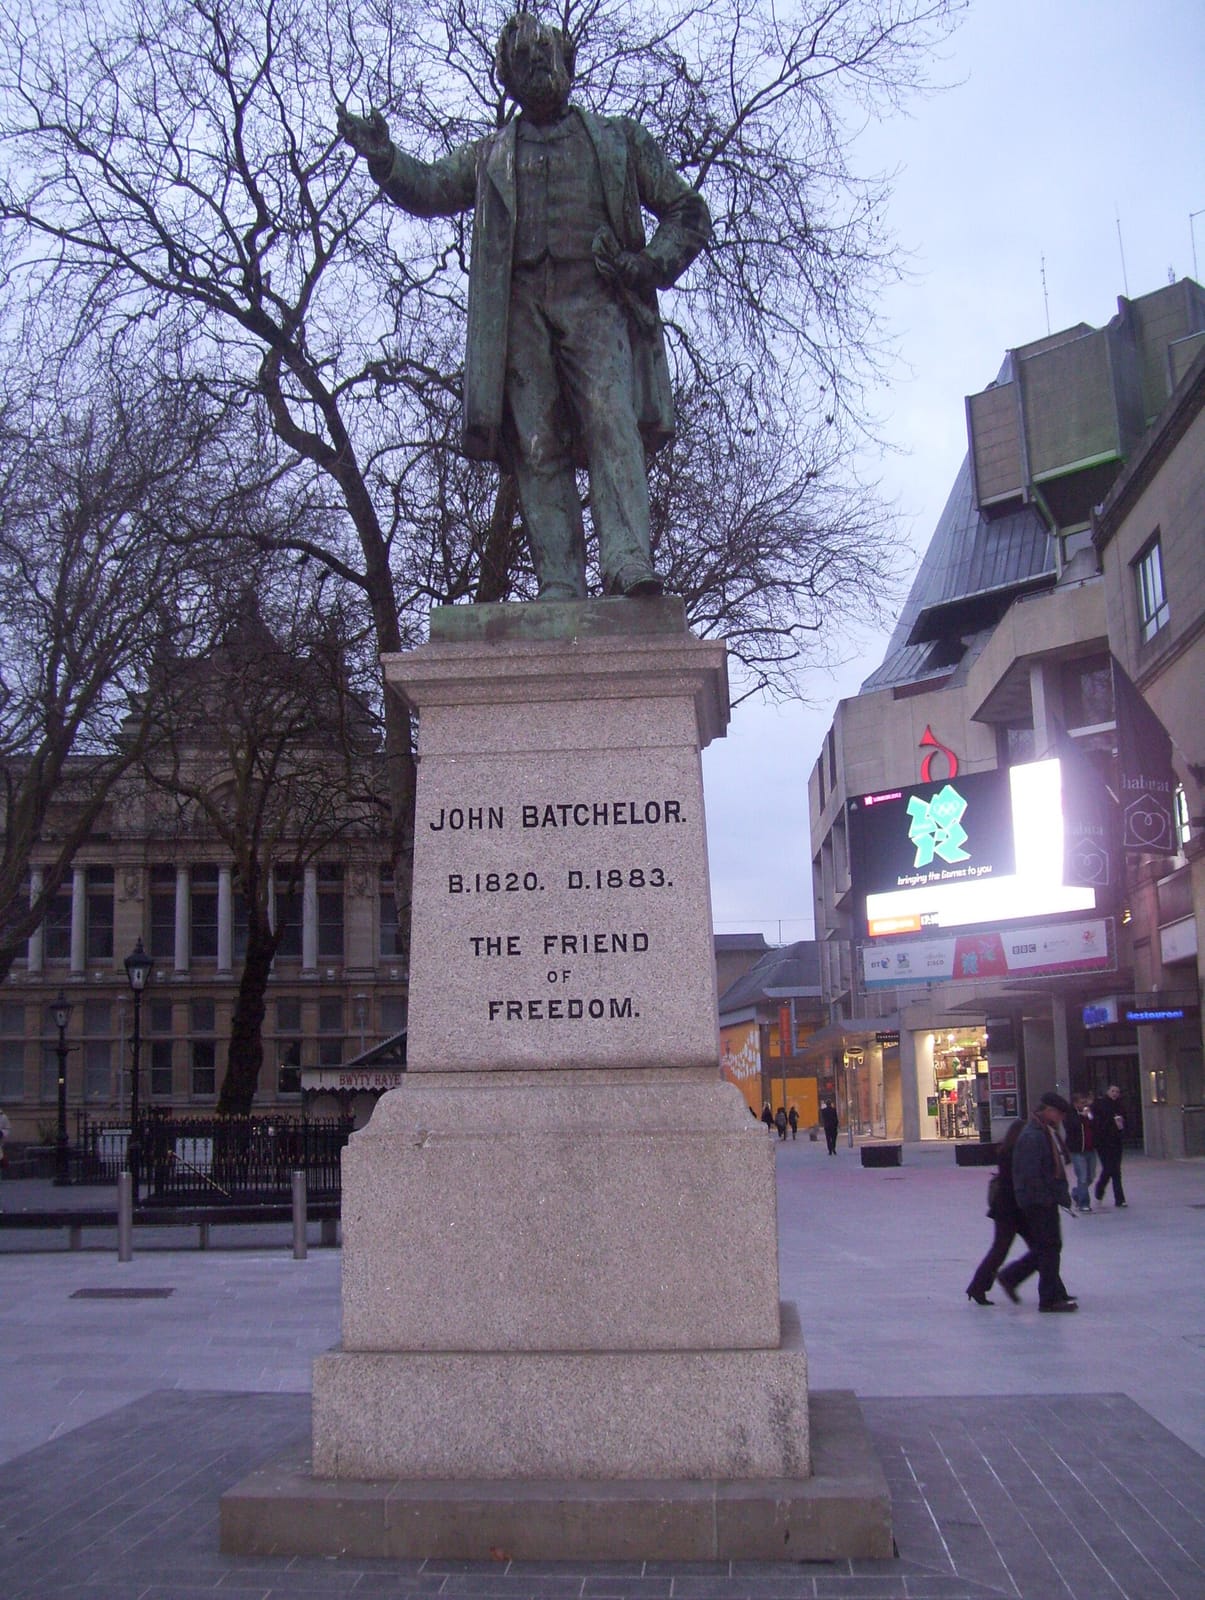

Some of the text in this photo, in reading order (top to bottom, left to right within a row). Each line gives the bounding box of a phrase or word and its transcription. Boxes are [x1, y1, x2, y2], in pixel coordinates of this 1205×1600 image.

[430, 801, 687, 830] JOHN BATCHELOR.
[449, 869, 672, 893] B.1820. D.1883.
[470, 934, 648, 955] THE FRIEND
[547, 970, 571, 983] OF
[488, 998, 639, 1020] FREEDOM.
